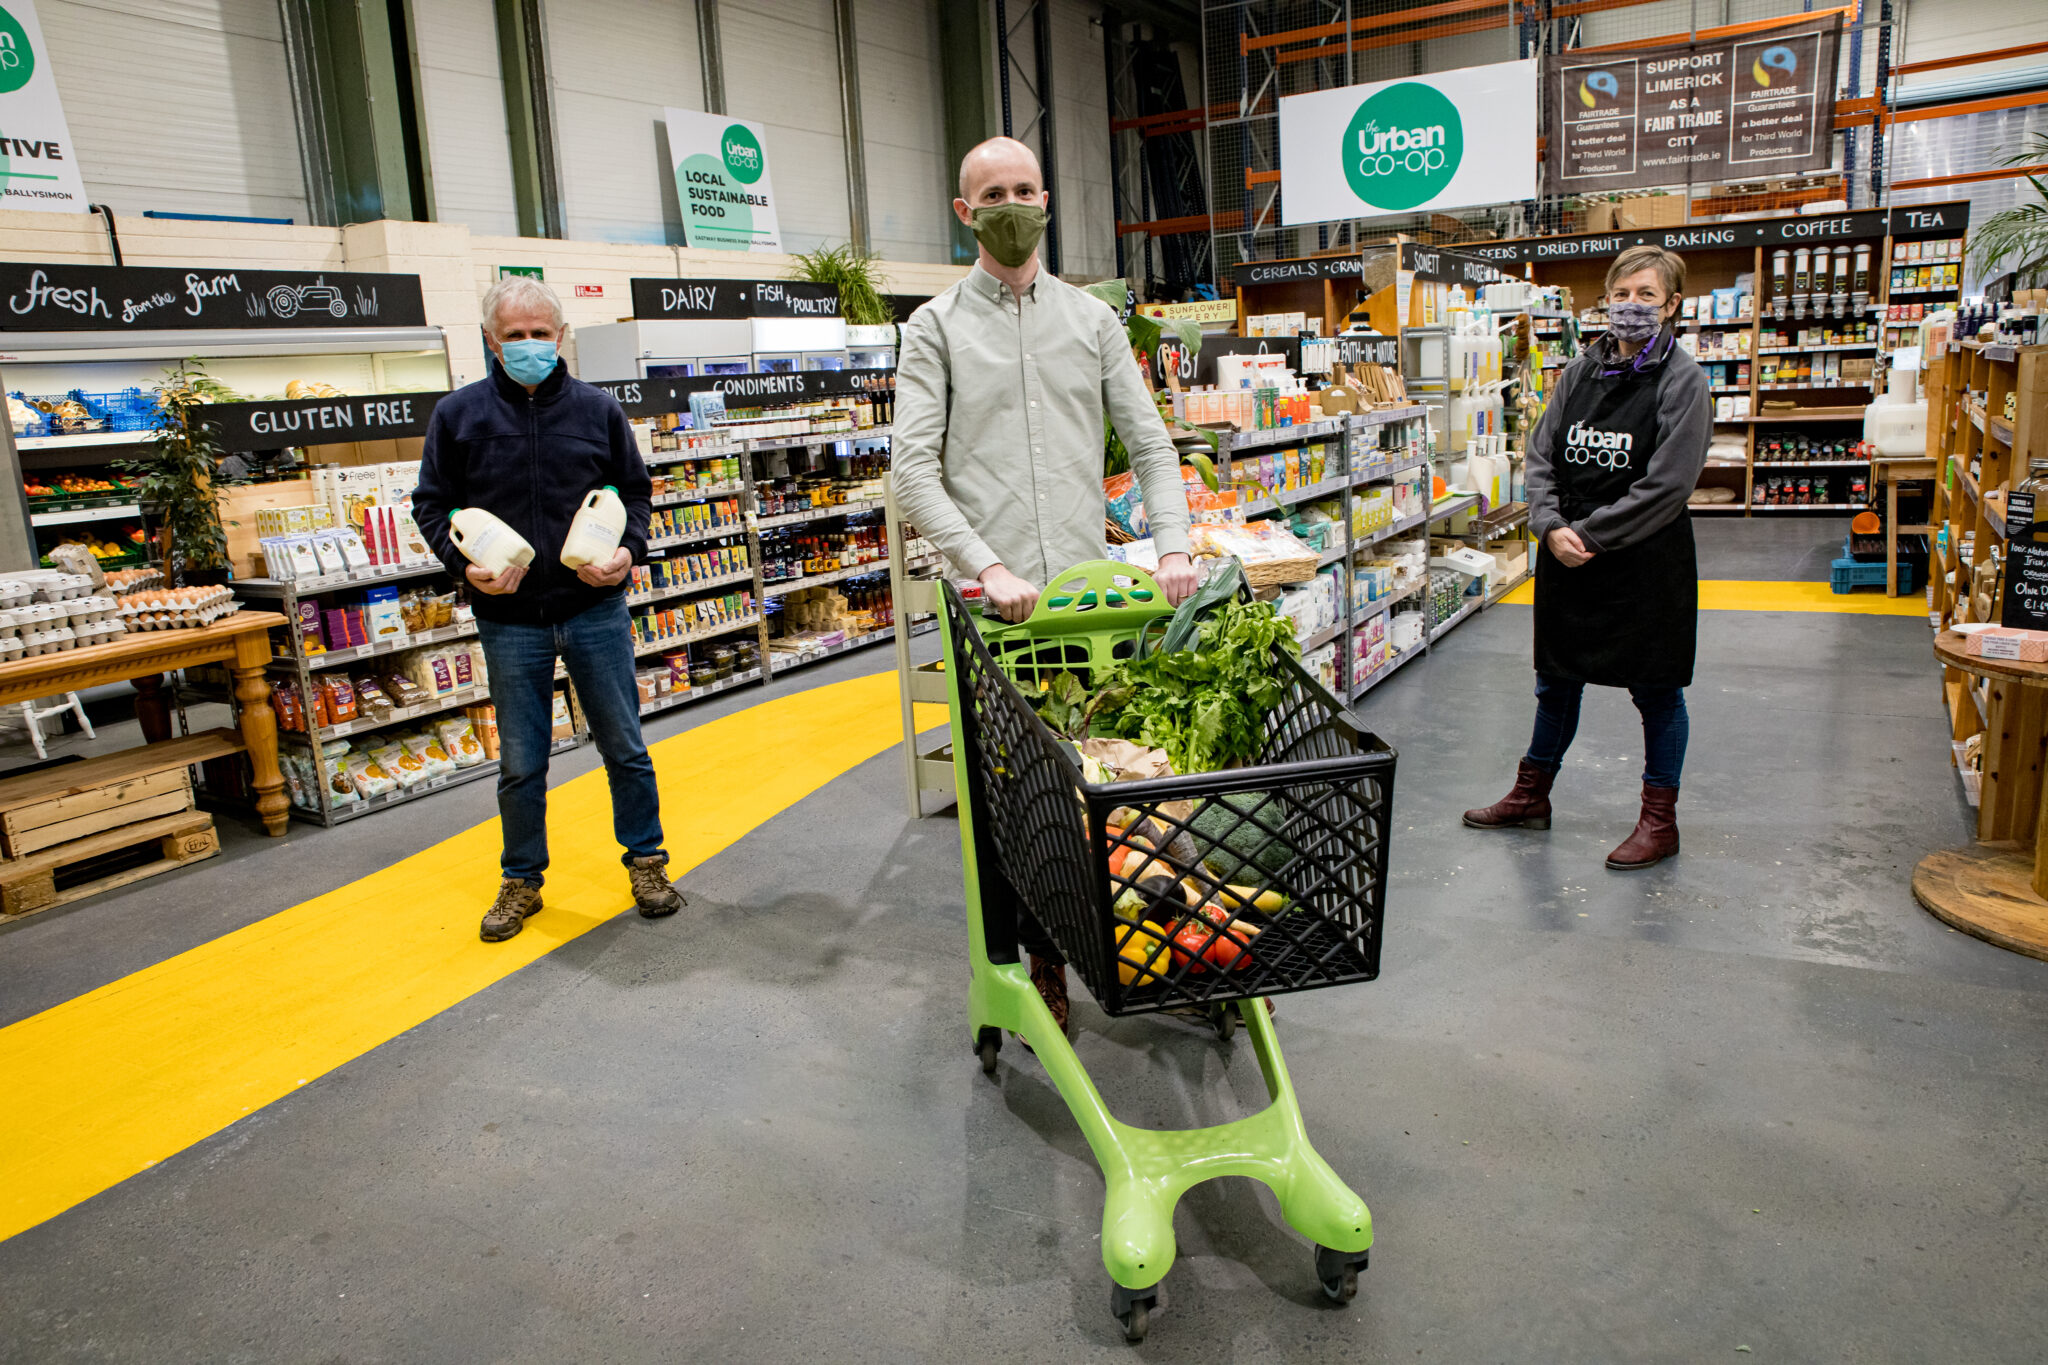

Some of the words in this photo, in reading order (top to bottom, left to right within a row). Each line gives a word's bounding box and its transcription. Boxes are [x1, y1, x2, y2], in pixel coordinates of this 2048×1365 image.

[1646, 52, 1724, 74] SUPPORT
[1645, 72, 1723, 94] LIMERICK
[1750, 86, 1797, 98] FAIRTRADE
[1668, 98, 1687, 110] AS
[1690, 97, 1700, 108] A
[1748, 100, 1796, 112] Guarantees
[1578, 108, 1620, 119] FAIRTRADE
[1644, 114, 1675, 133] FAIR
[1678, 110, 1723, 130] TRADE
[1750, 117, 1779, 127] better
[1781, 113, 1803, 123] deal
[1365, 119, 1380, 134] the
[1576, 121, 1620, 132] Guarantees
[1358, 125, 1445, 155] Urban
[1571, 138, 1577, 146] a
[1578, 136, 1605, 146] better
[1606, 133, 1626, 143] deal
[1667, 135, 1698, 148] CITY
[1741, 134, 1753, 143] for
[1755, 132, 1776, 142] Third
[1778, 129, 1802, 138] World
[726, 141, 757, 159] Urban
[1571, 152, 1582, 160] for
[1583, 150, 1602, 160] Third
[1603, 148, 1626, 158] World
[1750, 146, 1793, 157] Producers
[727, 154, 758, 170] co-op
[1359, 148, 1445, 176] co-op
[1643, 151, 1721, 167] www.fairtrade.ie
[1578, 164, 1618, 174] Producers
[685, 170, 726, 186] LOCAL
[5, 189, 74, 200] BALLYSIMON
[688, 187, 769, 207] SUSTAINABLE
[691, 203, 726, 218] FOOD
[1781, 217, 1853, 238] COFFEE
[1905, 211, 1945, 228] TEA
[1479, 246, 1518, 259] SEEDS
[1537, 241, 1580, 256] DRIED
[1582, 236, 1624, 253] FRUIT
[1664, 229, 1736, 248] BAKING
[1414, 250, 1440, 275] SONETT
[1251, 262, 1318, 281] CEREALS
[9, 269, 113, 319] fresh
[185, 273, 242, 316] farm
[661, 285, 718, 311] DAIRY
[756, 283, 785, 302] FISH
[793, 296, 838, 315] POULTRY
[122, 298, 152, 323] from
[152, 290, 176, 305] the
[1169, 302, 1229, 315] SUNFLOWER
[713, 374, 805, 396] CONDIMENTS
[250, 403, 354, 434] GLUTEN
[363, 400, 415, 426] FREE
[1566, 424, 1633, 450] Urban
[1565, 446, 1630, 472] co-op
[349, 471, 376, 480] freee
